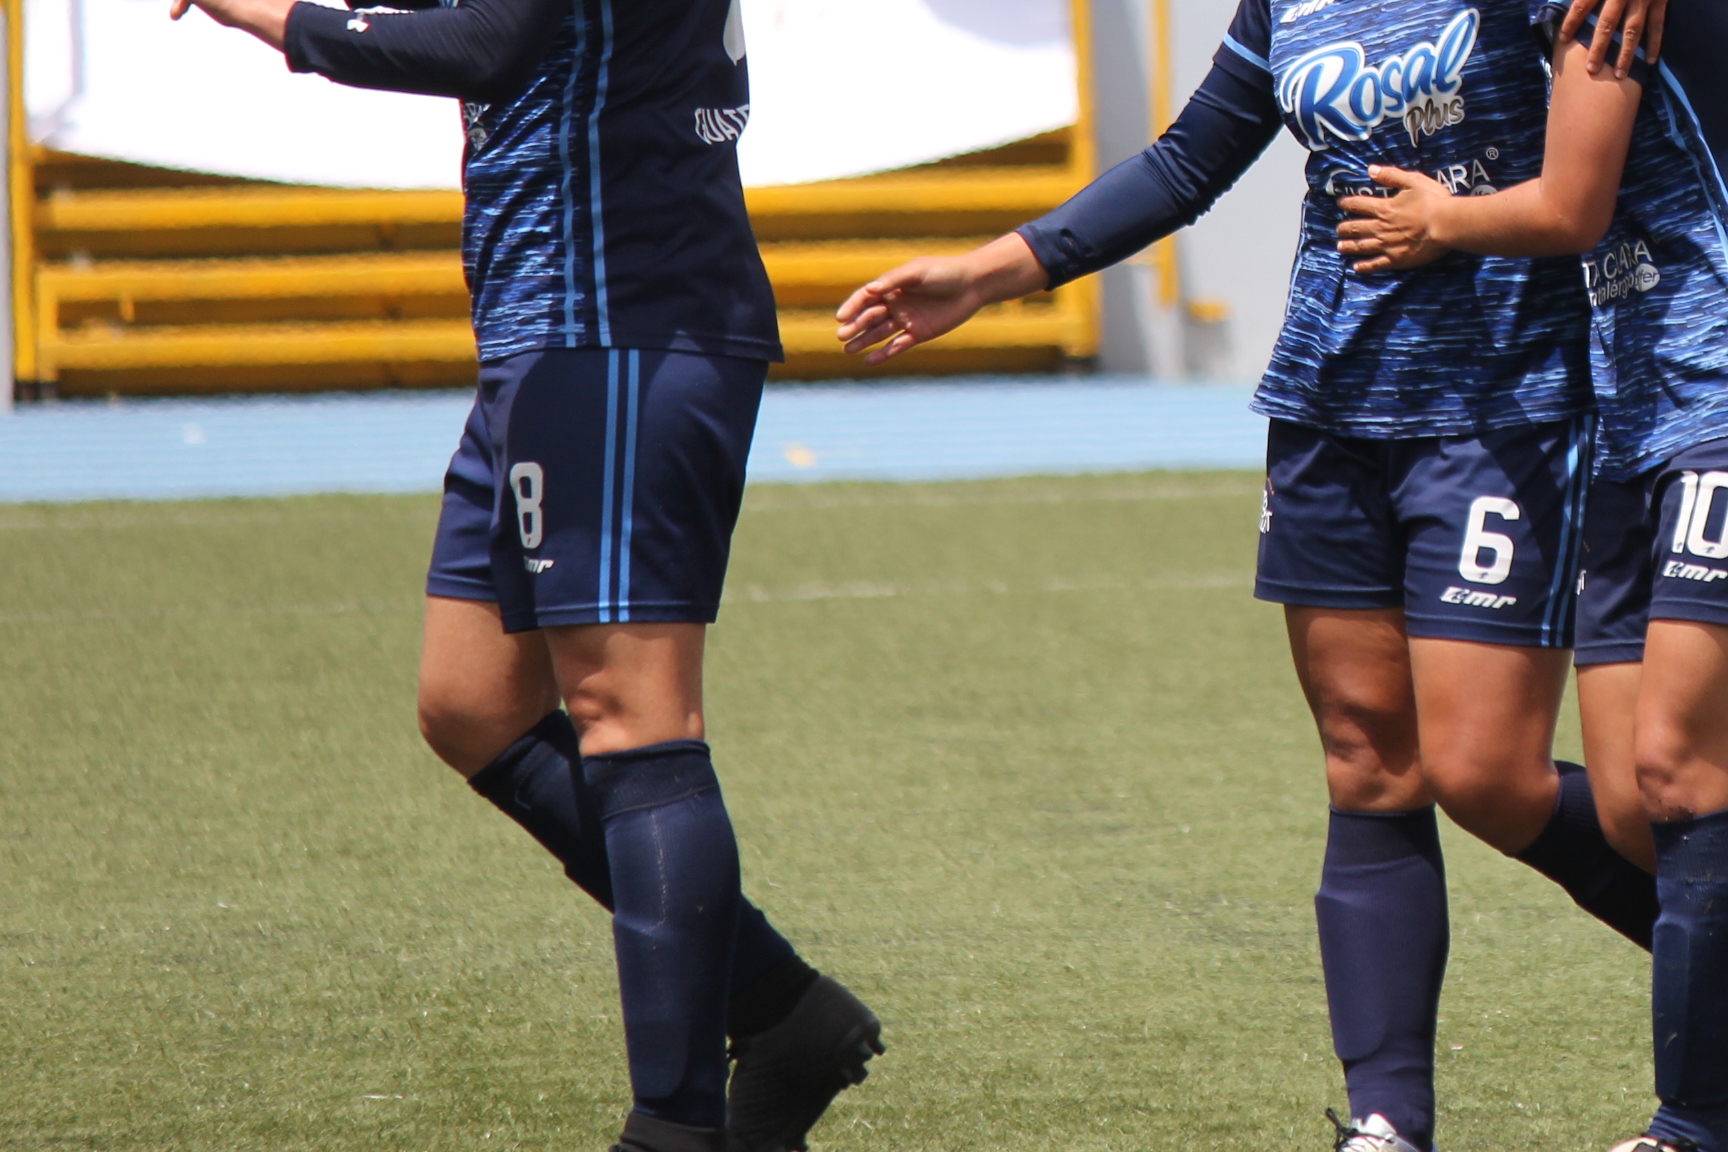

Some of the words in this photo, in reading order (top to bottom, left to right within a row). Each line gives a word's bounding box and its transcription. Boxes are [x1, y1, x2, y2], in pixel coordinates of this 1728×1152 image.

[1280, 8, 1480, 151] Rosal
[509, 461, 544, 549] 8
[1458, 495, 1520, 585] 6
